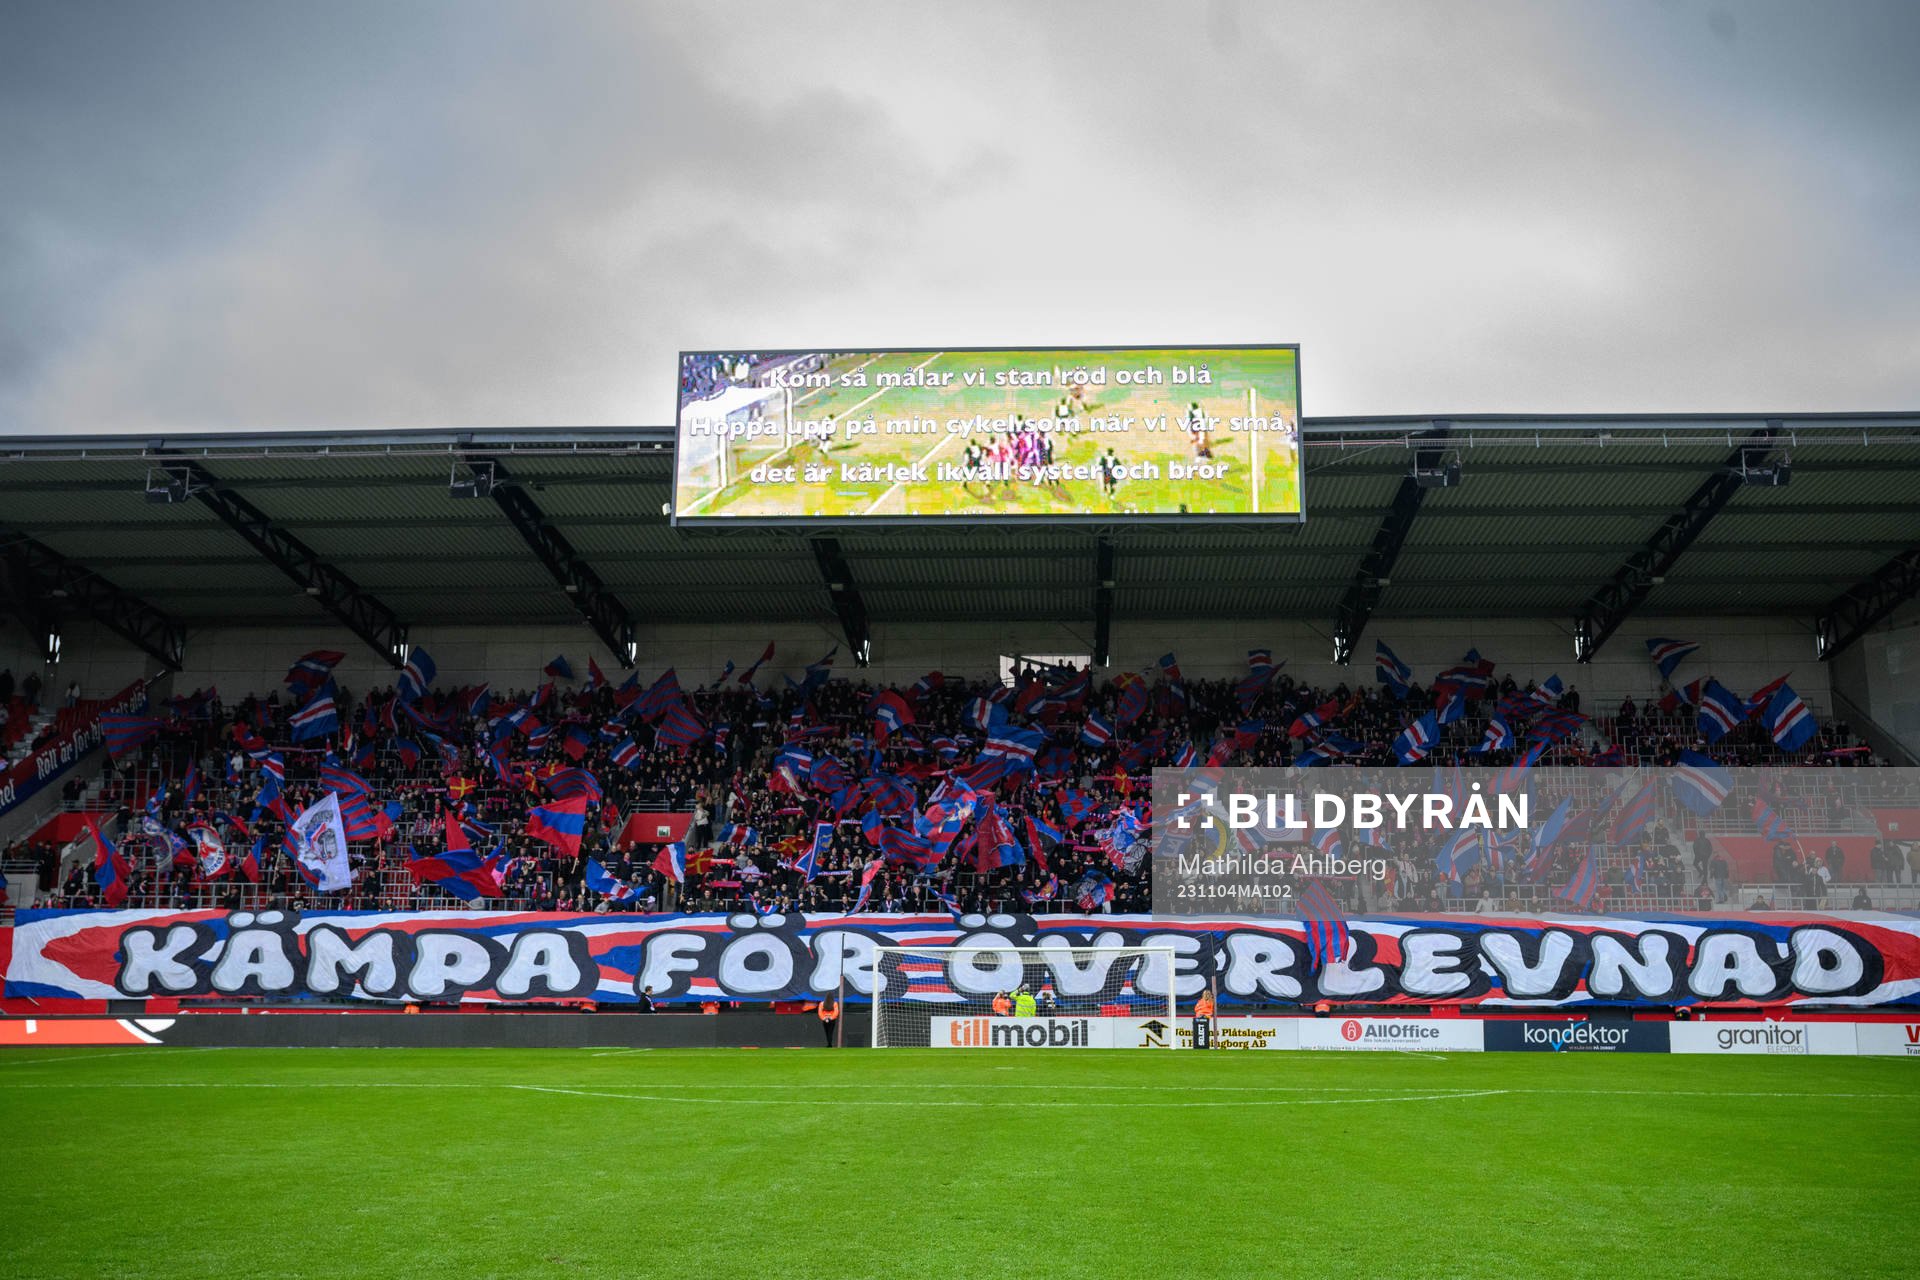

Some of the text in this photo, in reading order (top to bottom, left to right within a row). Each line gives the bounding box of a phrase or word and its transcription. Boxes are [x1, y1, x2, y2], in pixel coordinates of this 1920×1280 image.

[770, 364, 1212, 388] Kom så målar vi stan röd och blå
[690, 411, 1292, 440] Hoppa upp på min cykel som när vi var små,
[751, 461, 1229, 485] det är kärlek ikväll syster och bror
[59, 740, 74, 765] är
[73, 728, 91, 760] för
[121, 910, 582, 995] KÄMPA
[639, 913, 1865, 997] FÖR ÖVERLEVNAD
[950, 1018, 1088, 1047] tillmobil
[1222, 1028, 1276, 1039] Plåtslageri
[1364, 1024, 1440, 1038] AllOffice
[1524, 1022, 1630, 1044] kondektor
[1717, 1025, 1803, 1049] granitor
[1182, 1039, 1186, 1048] i
[1251, 1039, 1267, 1048] AB
[1767, 1045, 1805, 1054] ELECTRO
